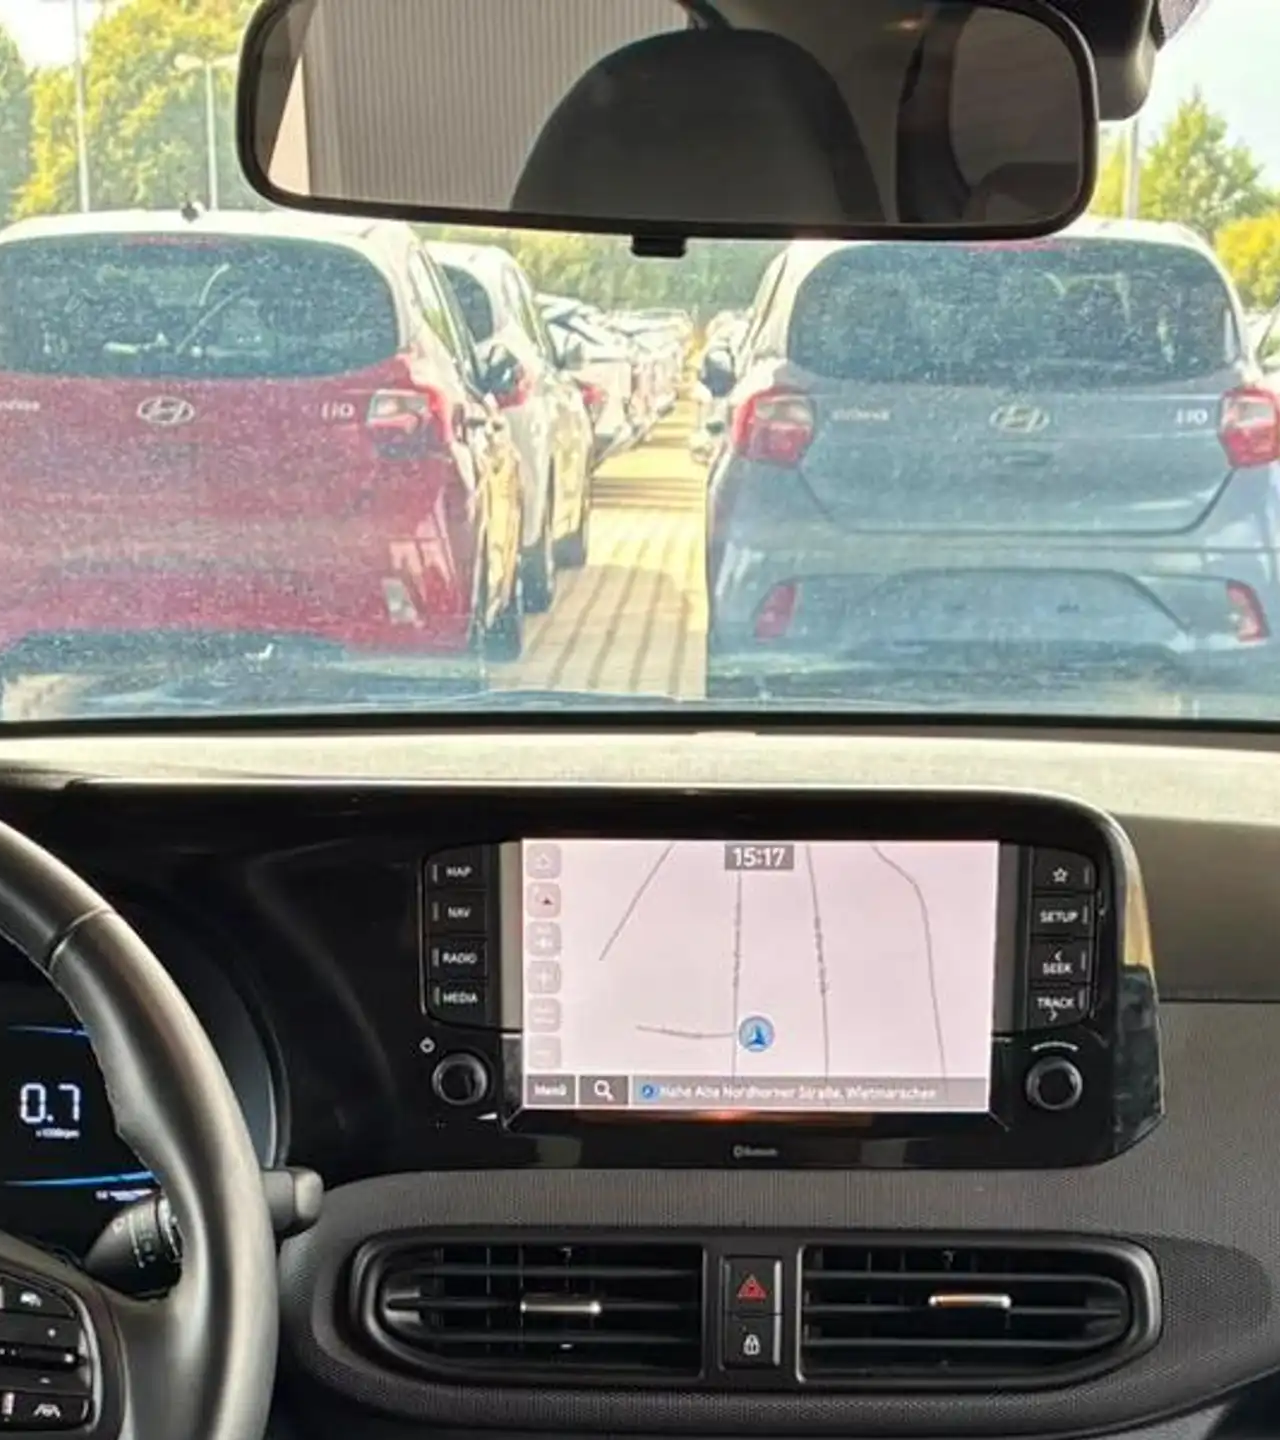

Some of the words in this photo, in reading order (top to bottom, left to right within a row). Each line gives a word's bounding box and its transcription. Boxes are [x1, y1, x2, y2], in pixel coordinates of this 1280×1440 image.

[732, 847, 785, 868] 15:17
[445, 865, 472, 877] MAP
[447, 907, 471, 918] NAV
[1039, 909, 1079, 923] SETUP
[442, 952, 478, 964] RADIO
[1042, 962, 1073, 975] SEEK
[443, 992, 479, 1004] MEDIA
[1037, 997, 1076, 1009] TRACK
[20, 1082, 81, 1124] 0.7
